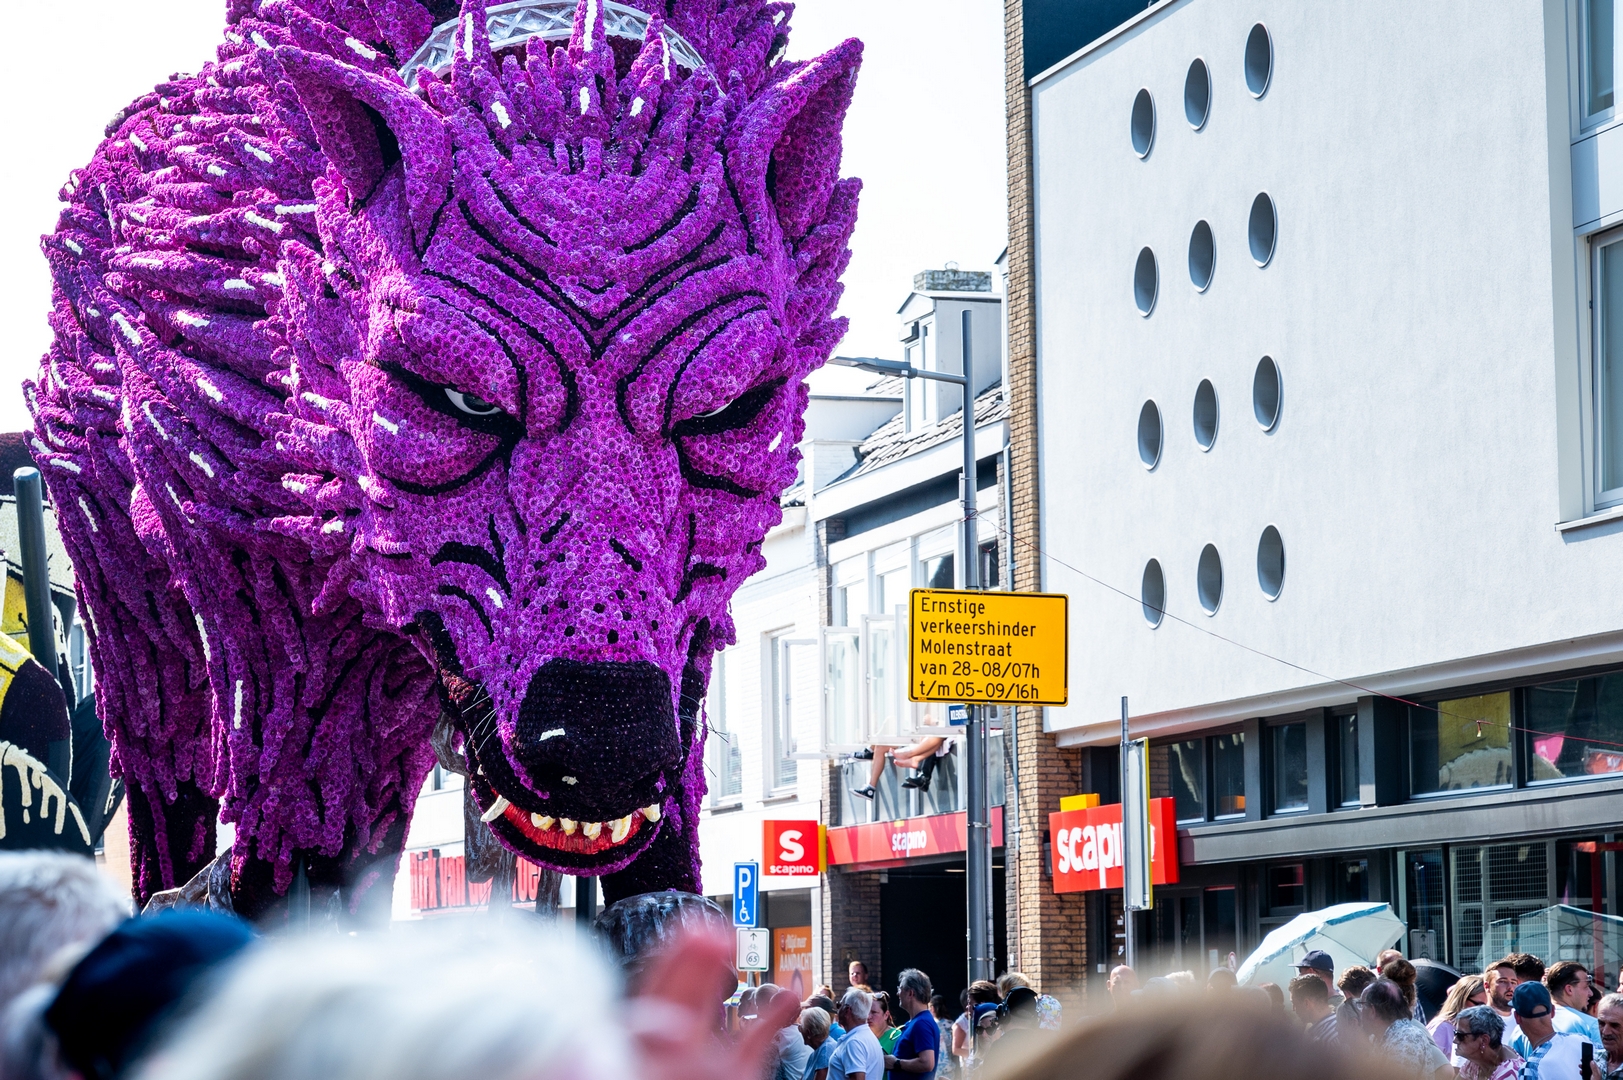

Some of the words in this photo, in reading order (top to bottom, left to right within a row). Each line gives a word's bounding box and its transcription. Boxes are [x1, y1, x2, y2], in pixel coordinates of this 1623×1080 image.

[921, 597, 985, 618] Ernstige
[920, 619, 1036, 637] verkeershinder
[921, 639, 1012, 657] Molenstraat
[920, 662, 947, 675] van
[952, 661, 1040, 679] 28-08/07h
[919, 680, 950, 696] t/m
[955, 681, 1039, 699] 05-09/16h
[778, 829, 805, 862] S
[891, 829, 927, 857] scapino
[1057, 823, 1156, 889] scapi
[769, 864, 814, 876] scapino
[738, 867, 752, 900] P
